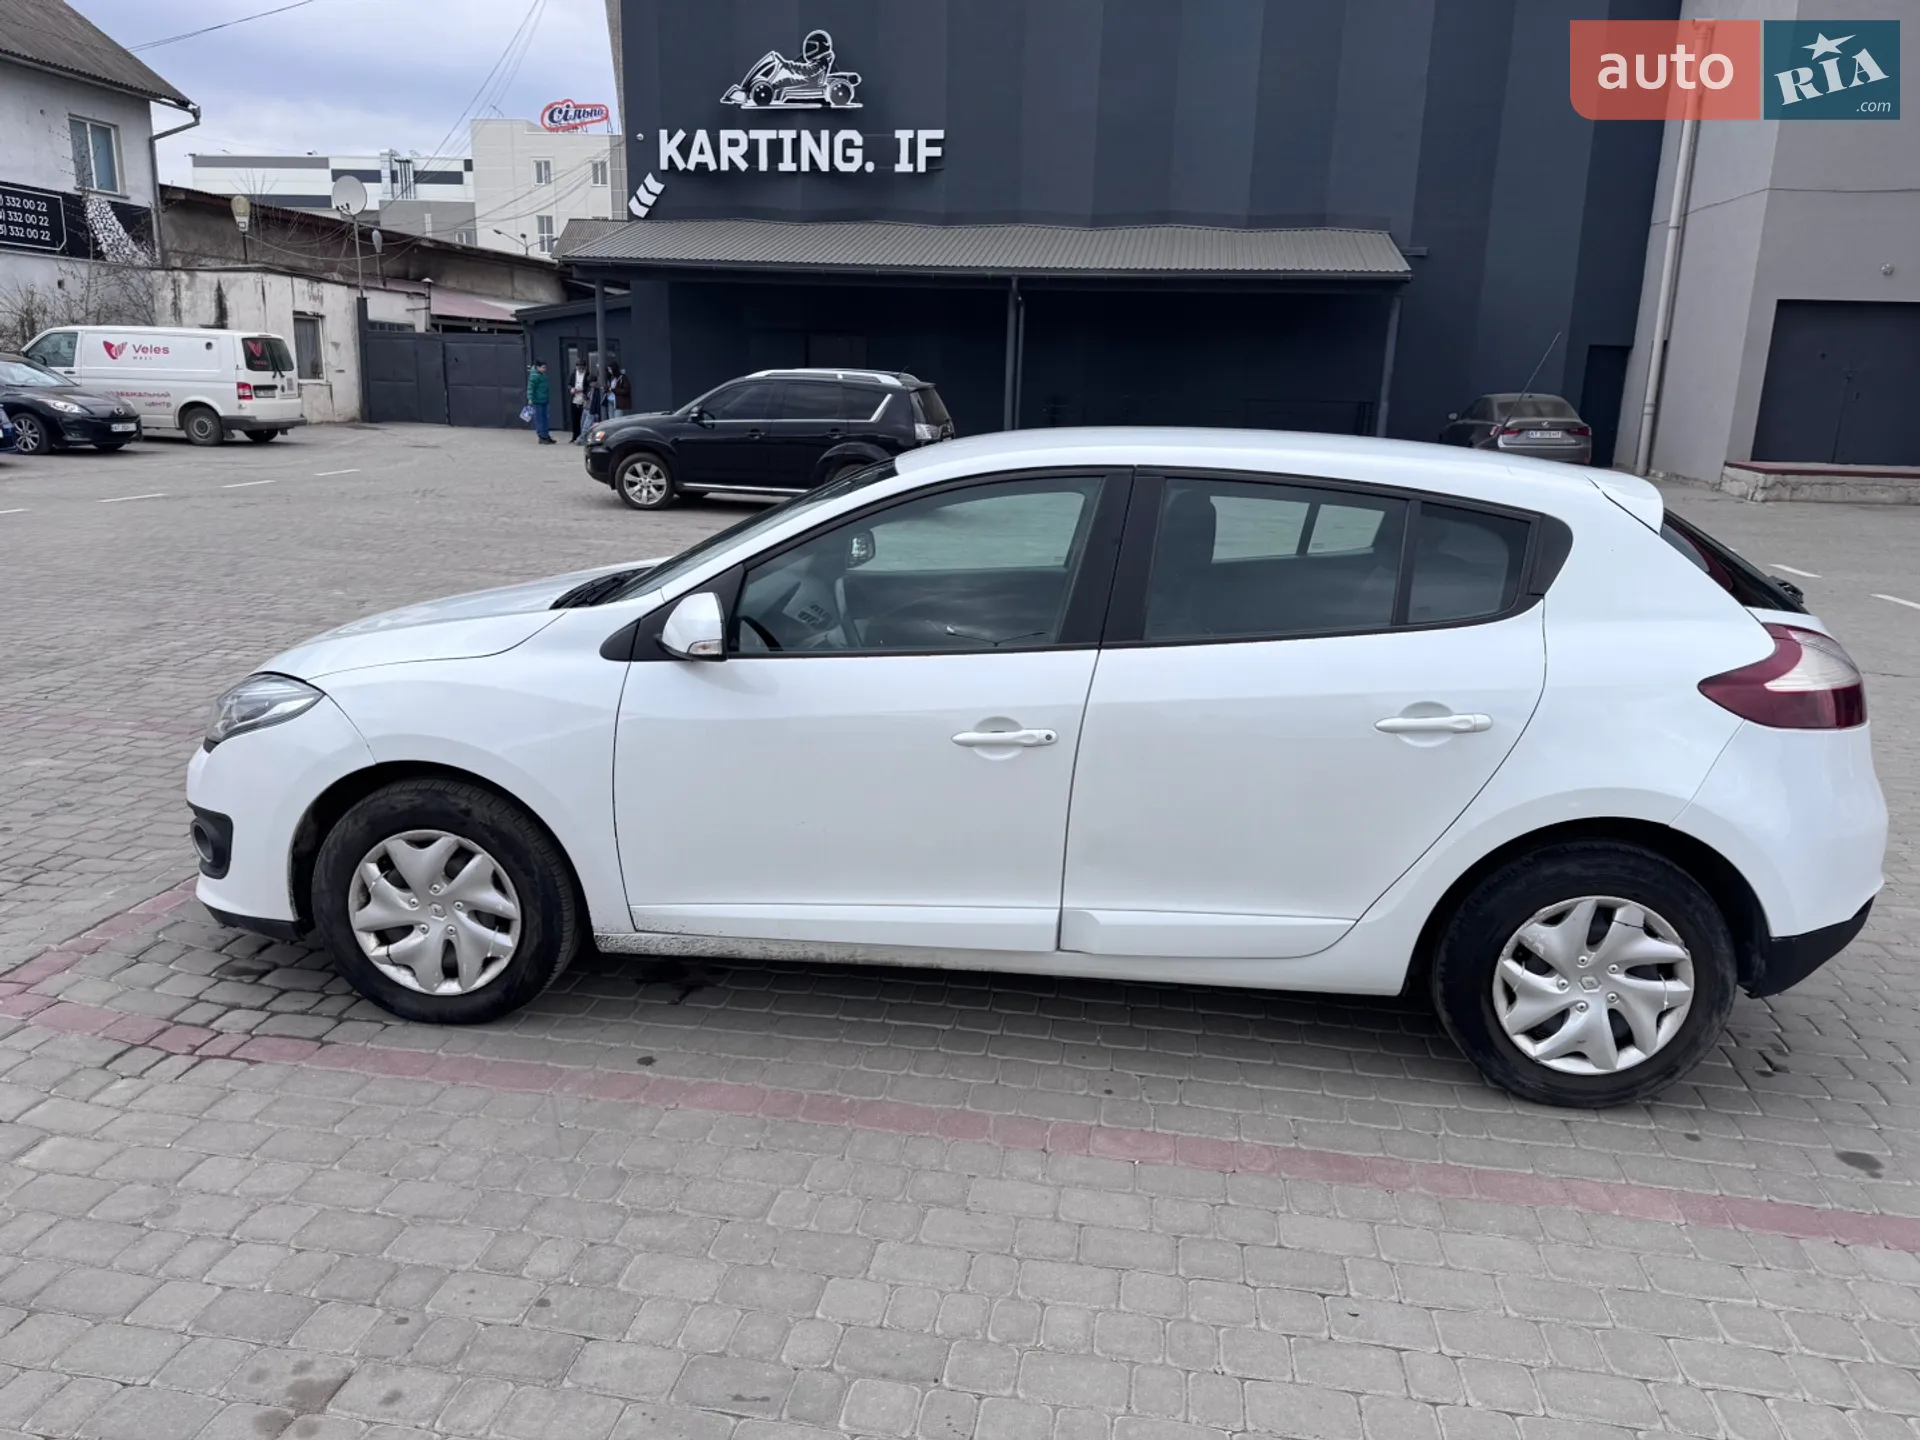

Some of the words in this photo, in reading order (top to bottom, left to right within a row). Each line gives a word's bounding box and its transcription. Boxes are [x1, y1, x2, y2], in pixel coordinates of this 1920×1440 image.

[548, 104, 604, 123] Сільпо
[659, 129, 875, 172] KARTING.
[894, 129, 945, 173] IF
[5, 196, 21, 207] 332
[22, 199, 36, 210] 00
[37, 201, 48, 212] 22
[7, 210, 24, 223] 332
[25, 213, 37, 224] 00
[39, 215, 49, 226] 22
[9, 225, 25, 237] 332
[26, 228, 39, 239] 00
[40, 230, 51, 240] 22
[132, 344, 170, 354] Veles
